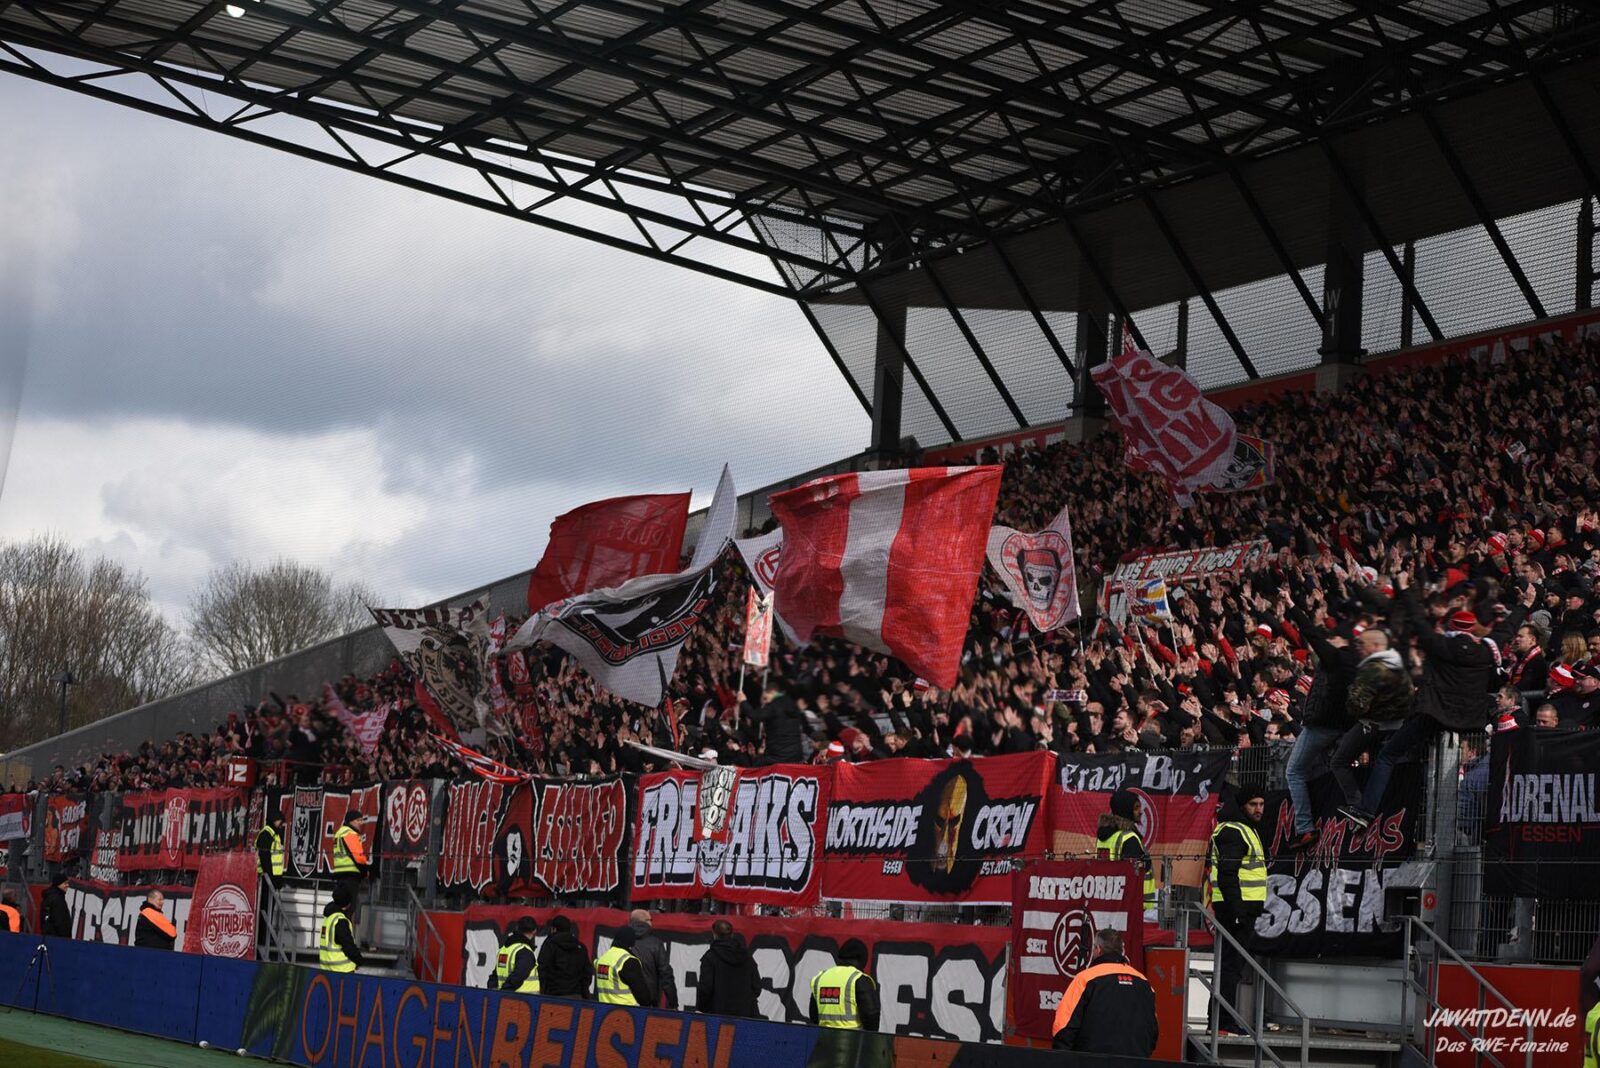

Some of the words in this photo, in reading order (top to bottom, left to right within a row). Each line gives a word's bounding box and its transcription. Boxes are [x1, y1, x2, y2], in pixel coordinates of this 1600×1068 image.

[1499, 773, 1600, 823] ADRENAL
[825, 803, 923, 850] NORTHSIDE
[971, 801, 1035, 851] CREW
[1522, 825, 1582, 844] ESSEN
[1028, 875, 1126, 900] KATEGORIE
[1254, 869, 1402, 938] SSEN
[1026, 938, 1048, 954] SEIT
